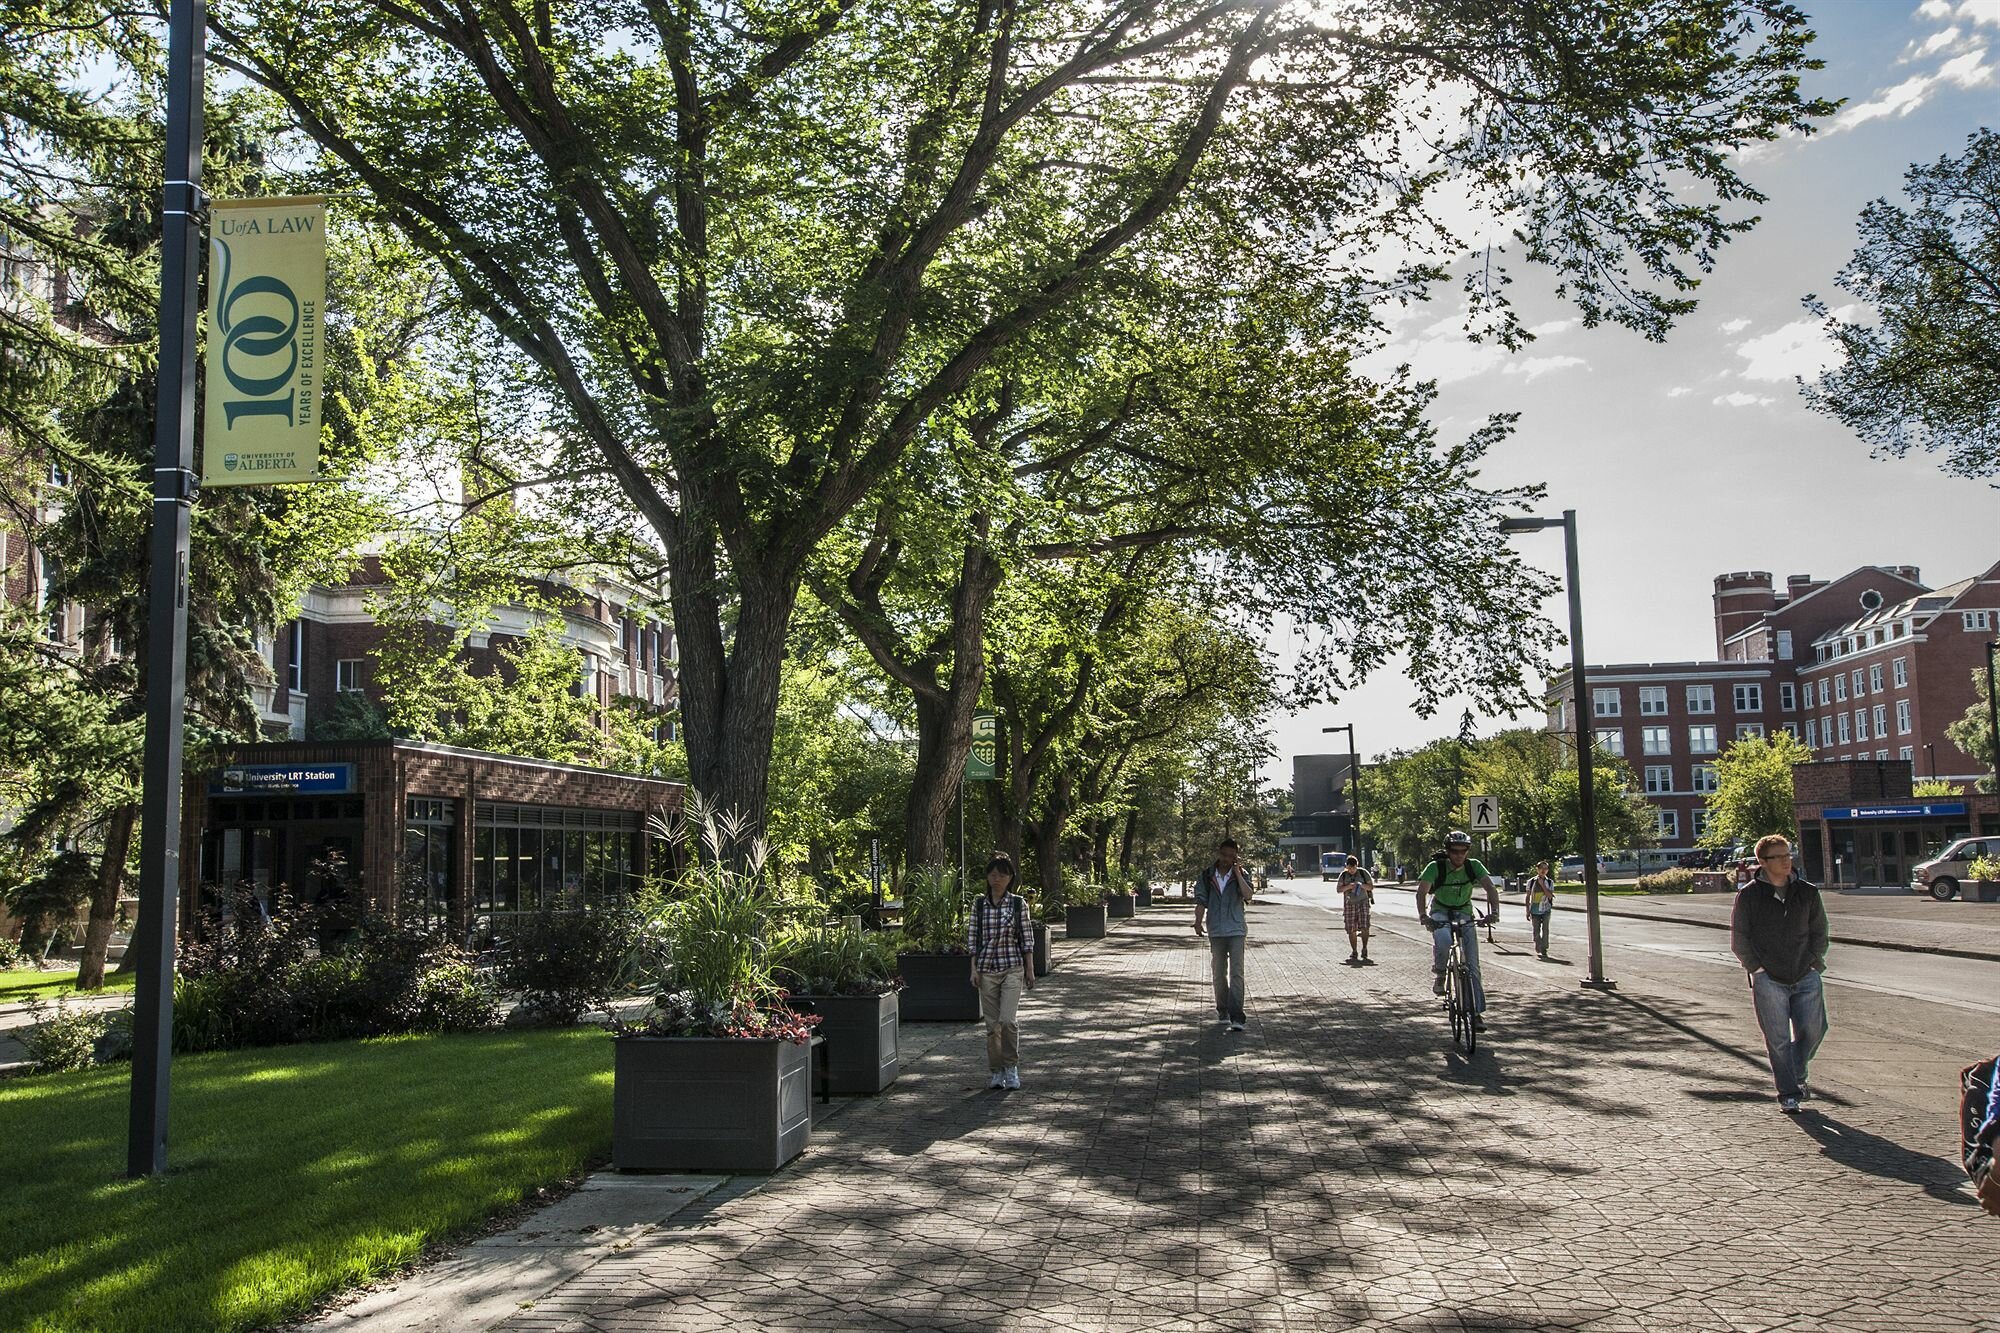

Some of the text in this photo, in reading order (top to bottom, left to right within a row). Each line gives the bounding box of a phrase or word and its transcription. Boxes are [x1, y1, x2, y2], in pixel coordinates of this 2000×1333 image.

[267, 216, 315, 234] LAW
[223, 276, 299, 431] 100
[299, 300, 315, 426] YEARS OF EXCELLENCE
[239, 458, 297, 470] ALBERTA
[246, 771, 335, 782] University LRT Station
